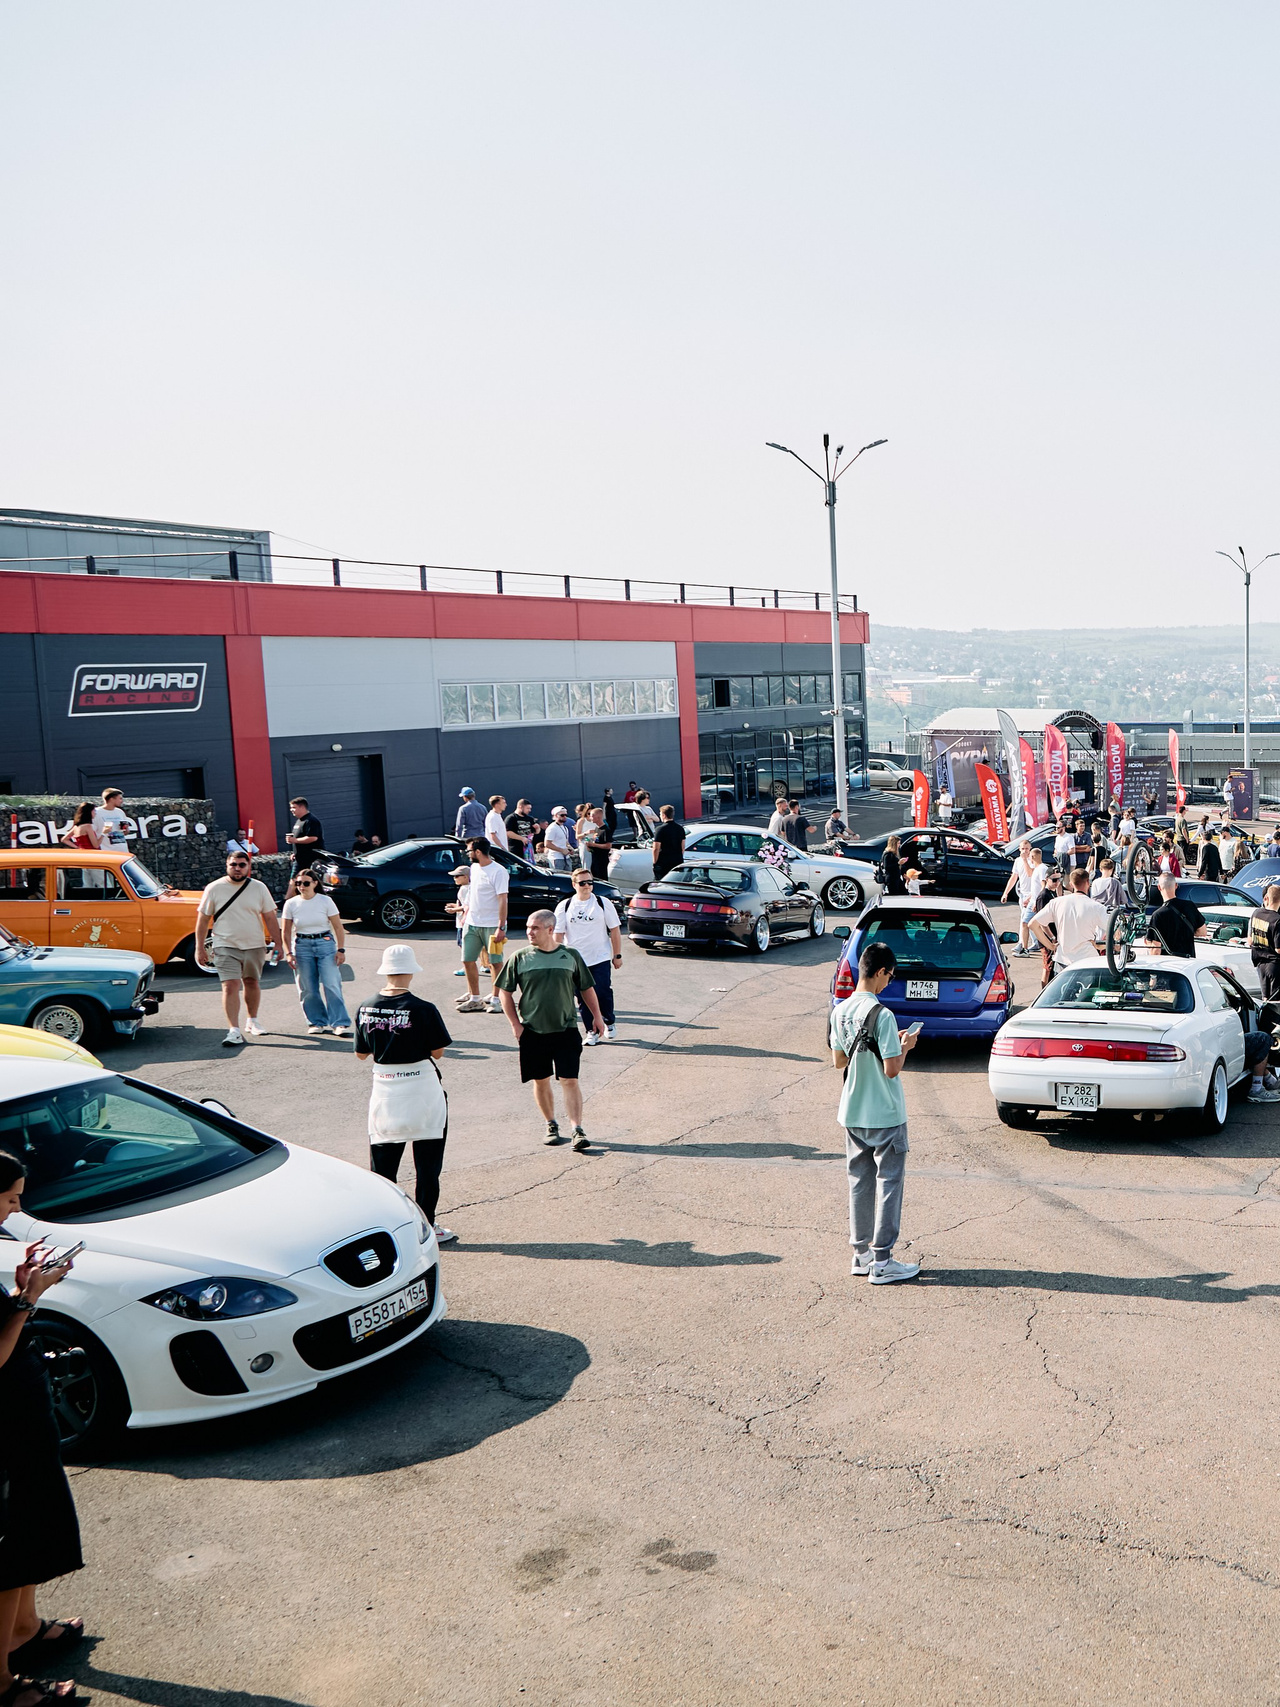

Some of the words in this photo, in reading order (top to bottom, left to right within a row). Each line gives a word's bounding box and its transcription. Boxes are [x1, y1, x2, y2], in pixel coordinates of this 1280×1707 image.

[80, 672, 198, 691] FORWARD
[84, 692, 191, 704] RACING
[993, 795, 1004, 840] TAKAYAMA
[90, 917, 110, 925] COFFEE
[396, 1070, 420, 1078] friend
[1074, 1086, 1092, 1096] 282
[1061, 1096, 1075, 1106] ЕХ
[1079, 1097, 1095, 1105] 124
[407, 1283, 425, 1302] 154
